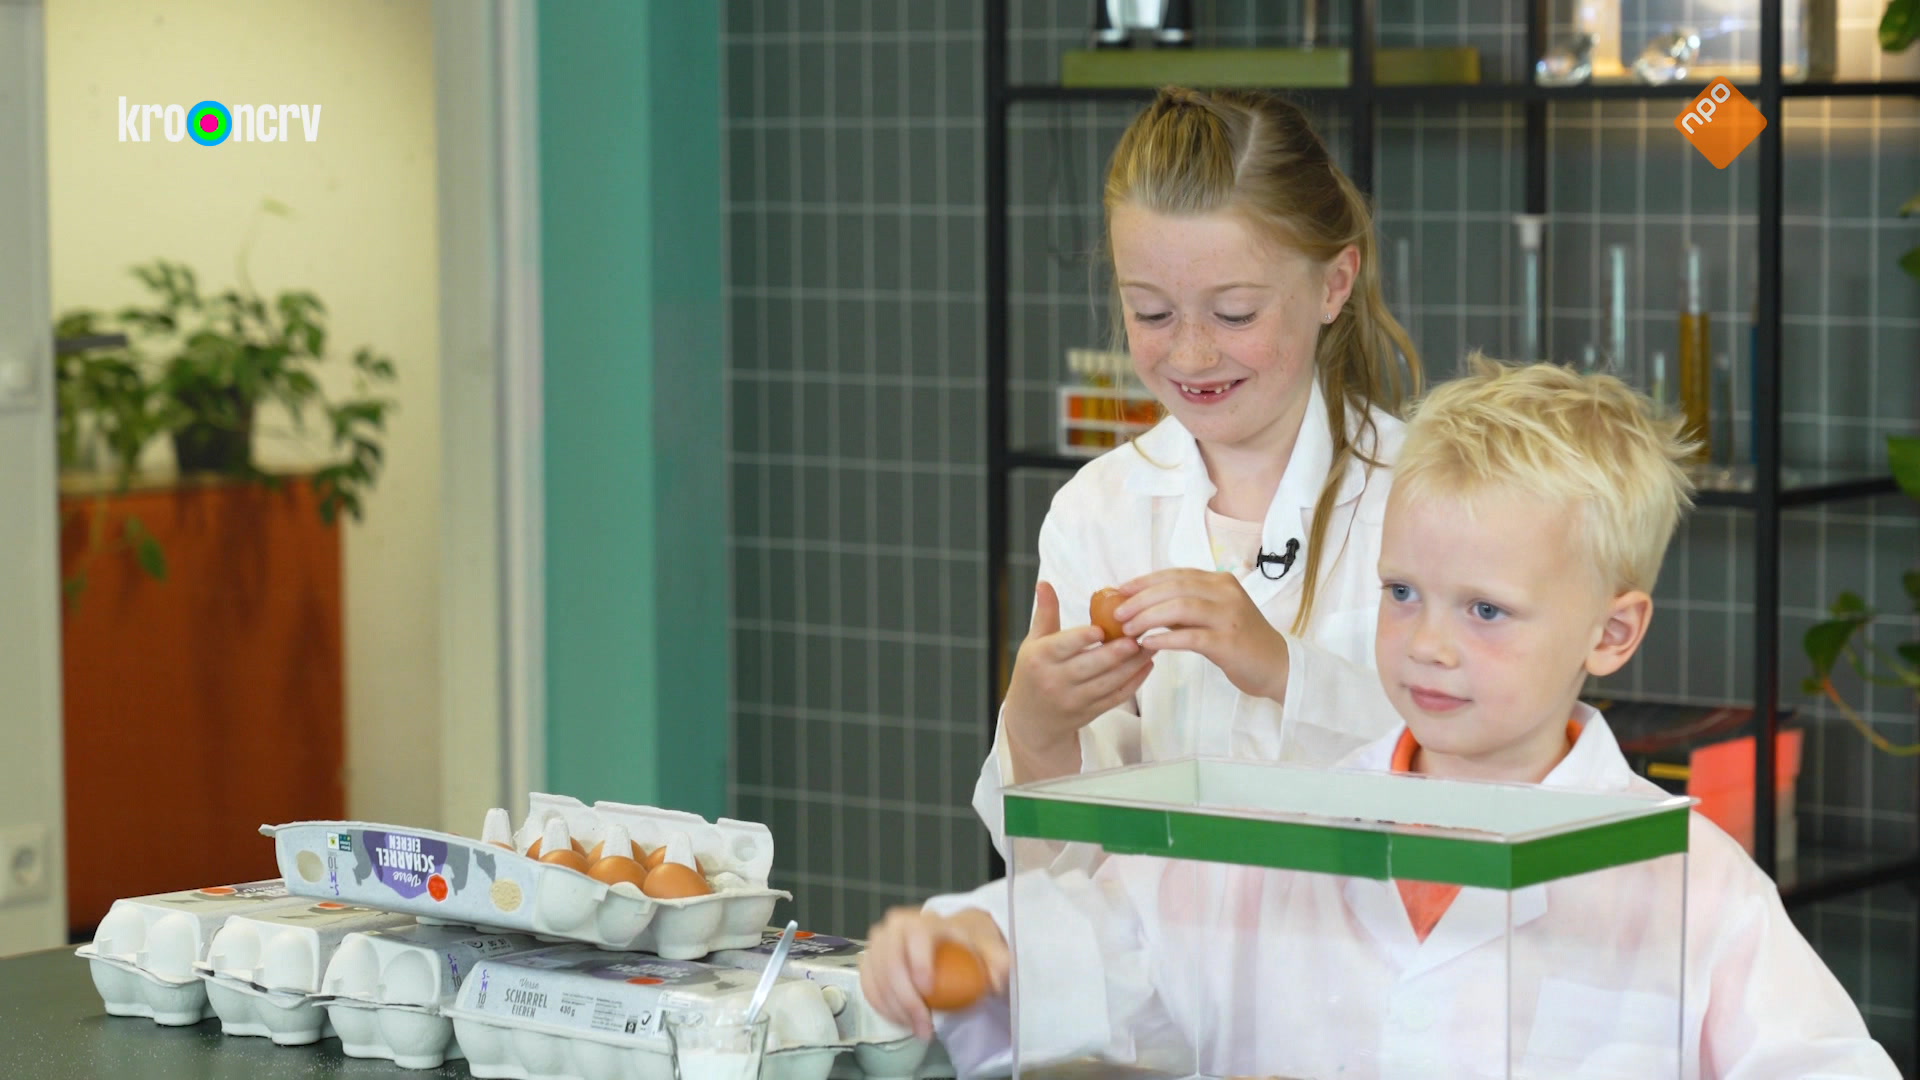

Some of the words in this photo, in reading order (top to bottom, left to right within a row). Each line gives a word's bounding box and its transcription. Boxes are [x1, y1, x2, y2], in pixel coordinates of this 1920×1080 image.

[388, 835, 421, 850] EIEREN
[327, 856, 339, 870] 10
[375, 847, 435, 873] SCHARREL
[393, 871, 422, 887] Verse
[518, 977, 540, 991] Verse
[478, 992, 487, 1005] 10
[504, 988, 548, 1010] SCHARREL
[511, 1006, 535, 1018] EIEREN
